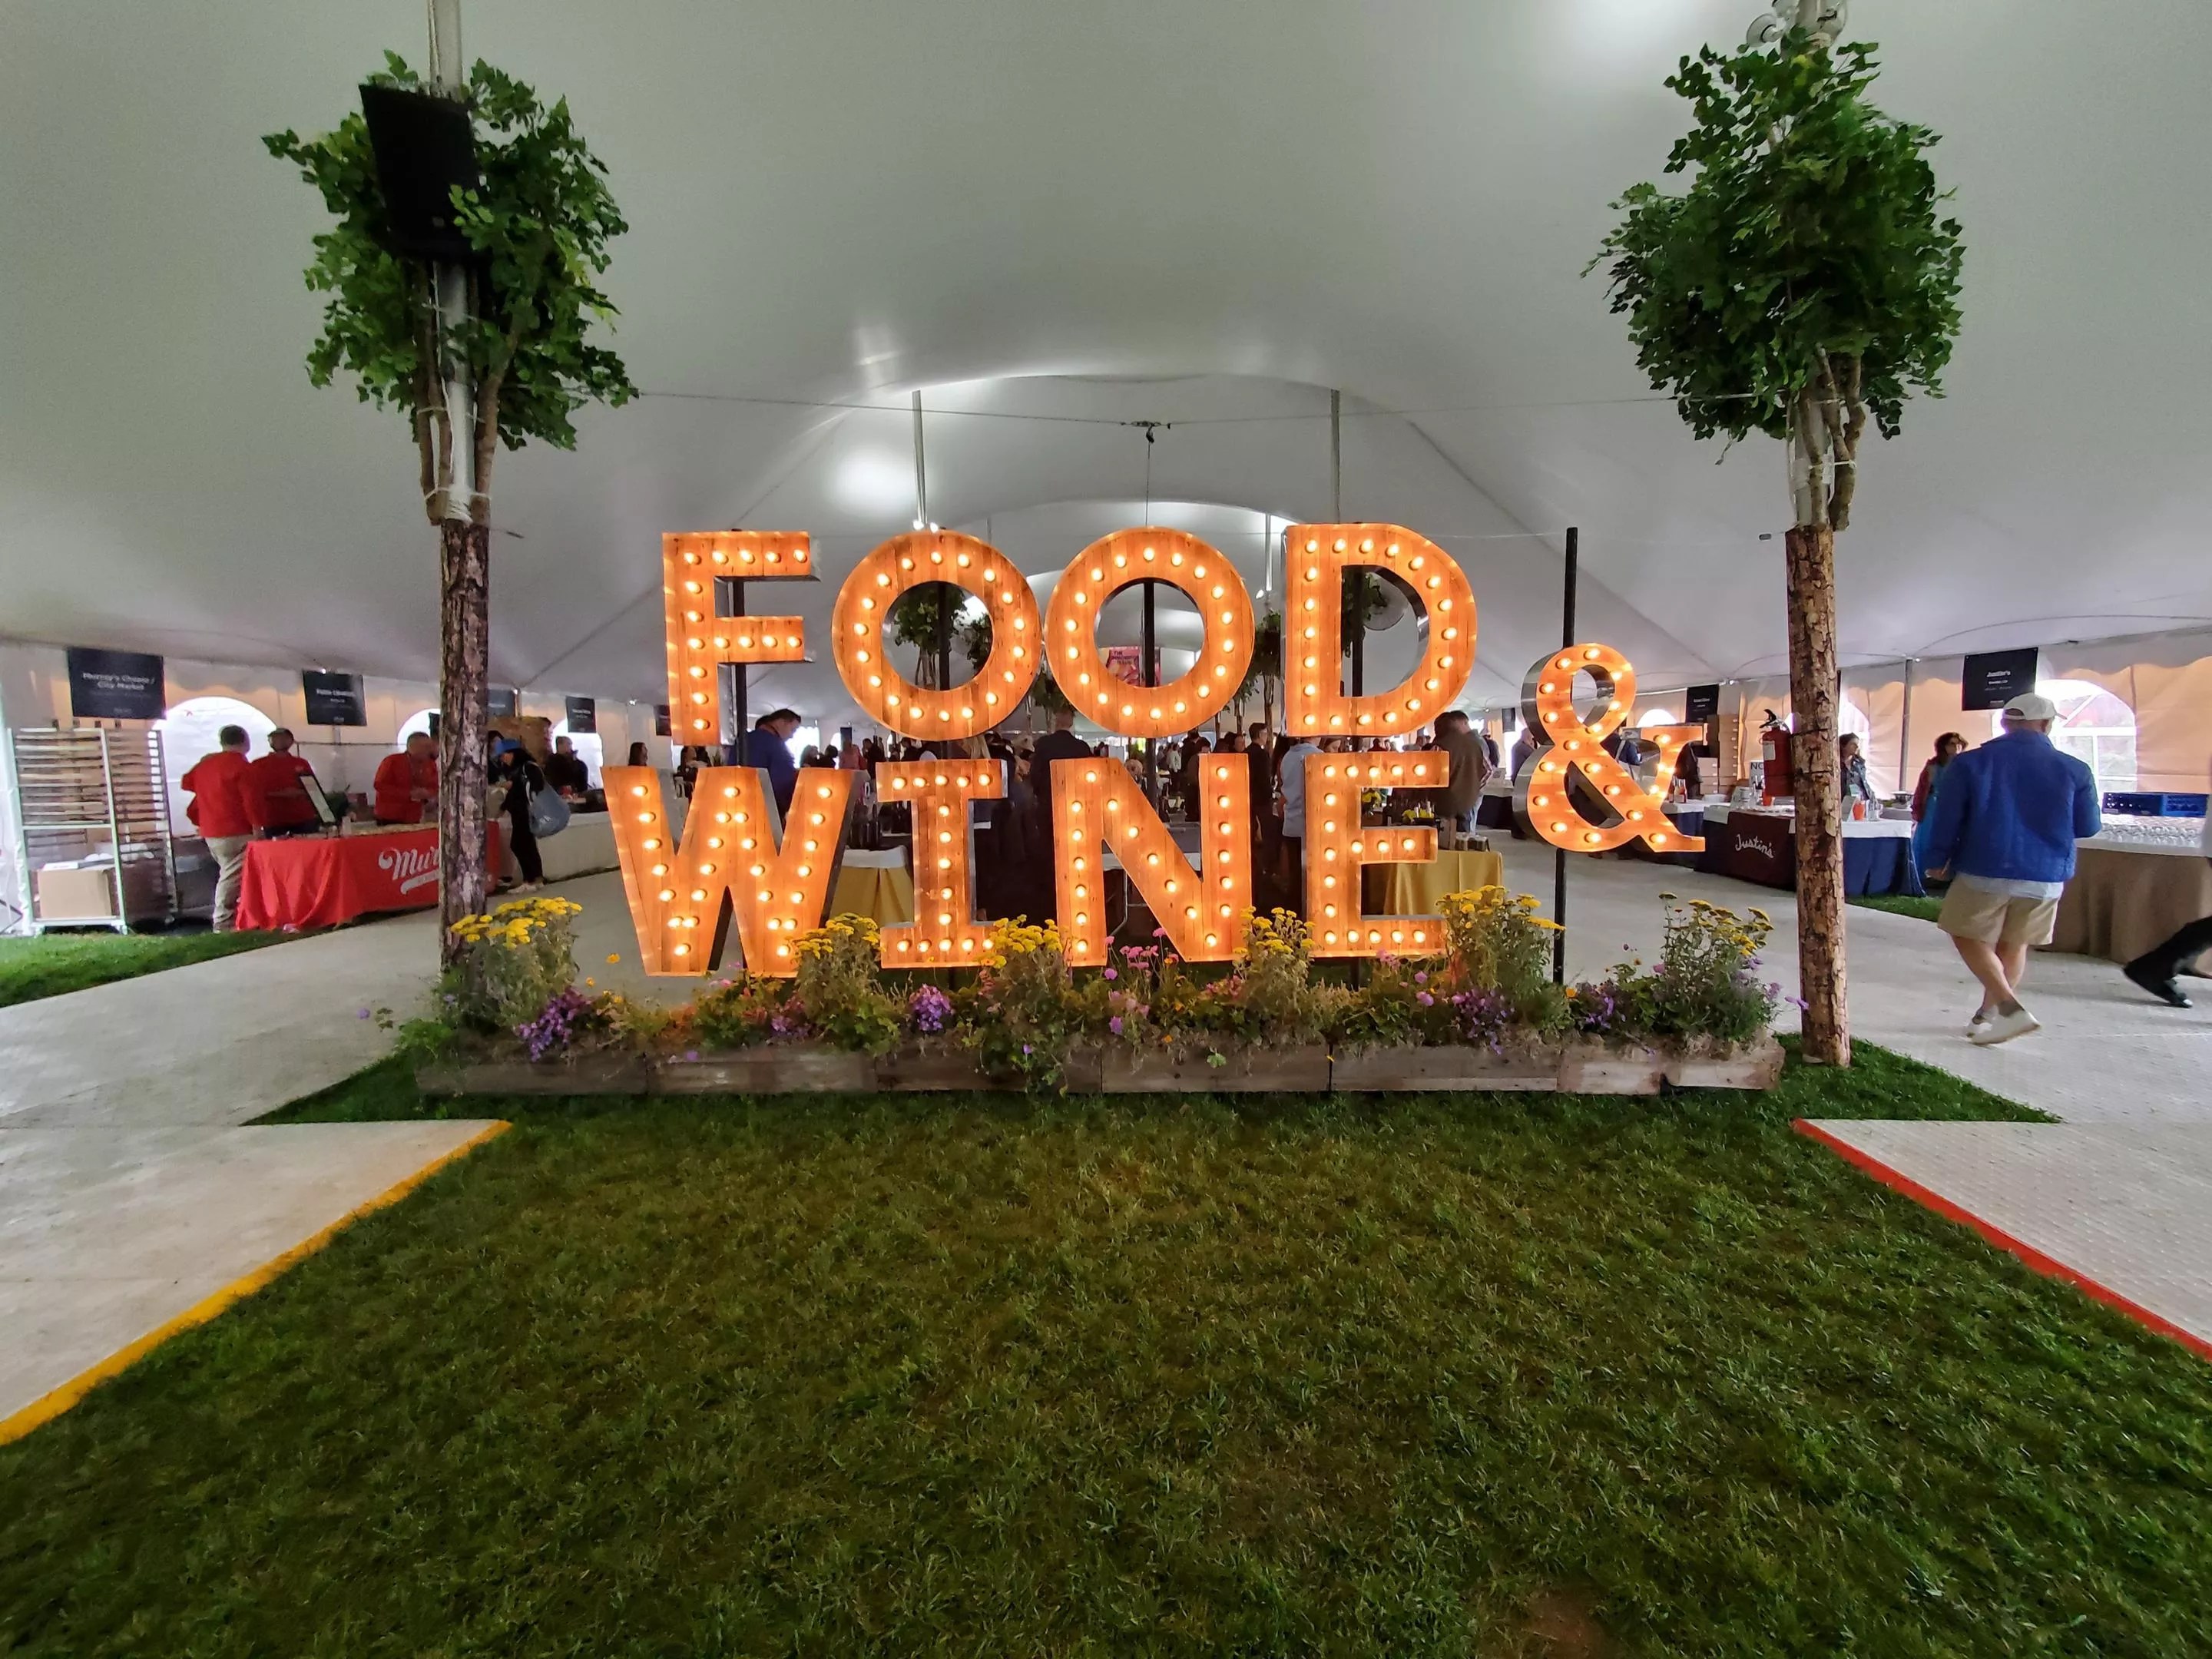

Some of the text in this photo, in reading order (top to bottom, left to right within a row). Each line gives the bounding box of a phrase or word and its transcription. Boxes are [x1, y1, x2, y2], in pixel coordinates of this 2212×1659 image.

[662, 522, 1478, 745] FOOD
[1521, 643, 1706, 853] &
[1735, 833, 1774, 859] Justin's
[601, 750, 1450, 978] WINE
